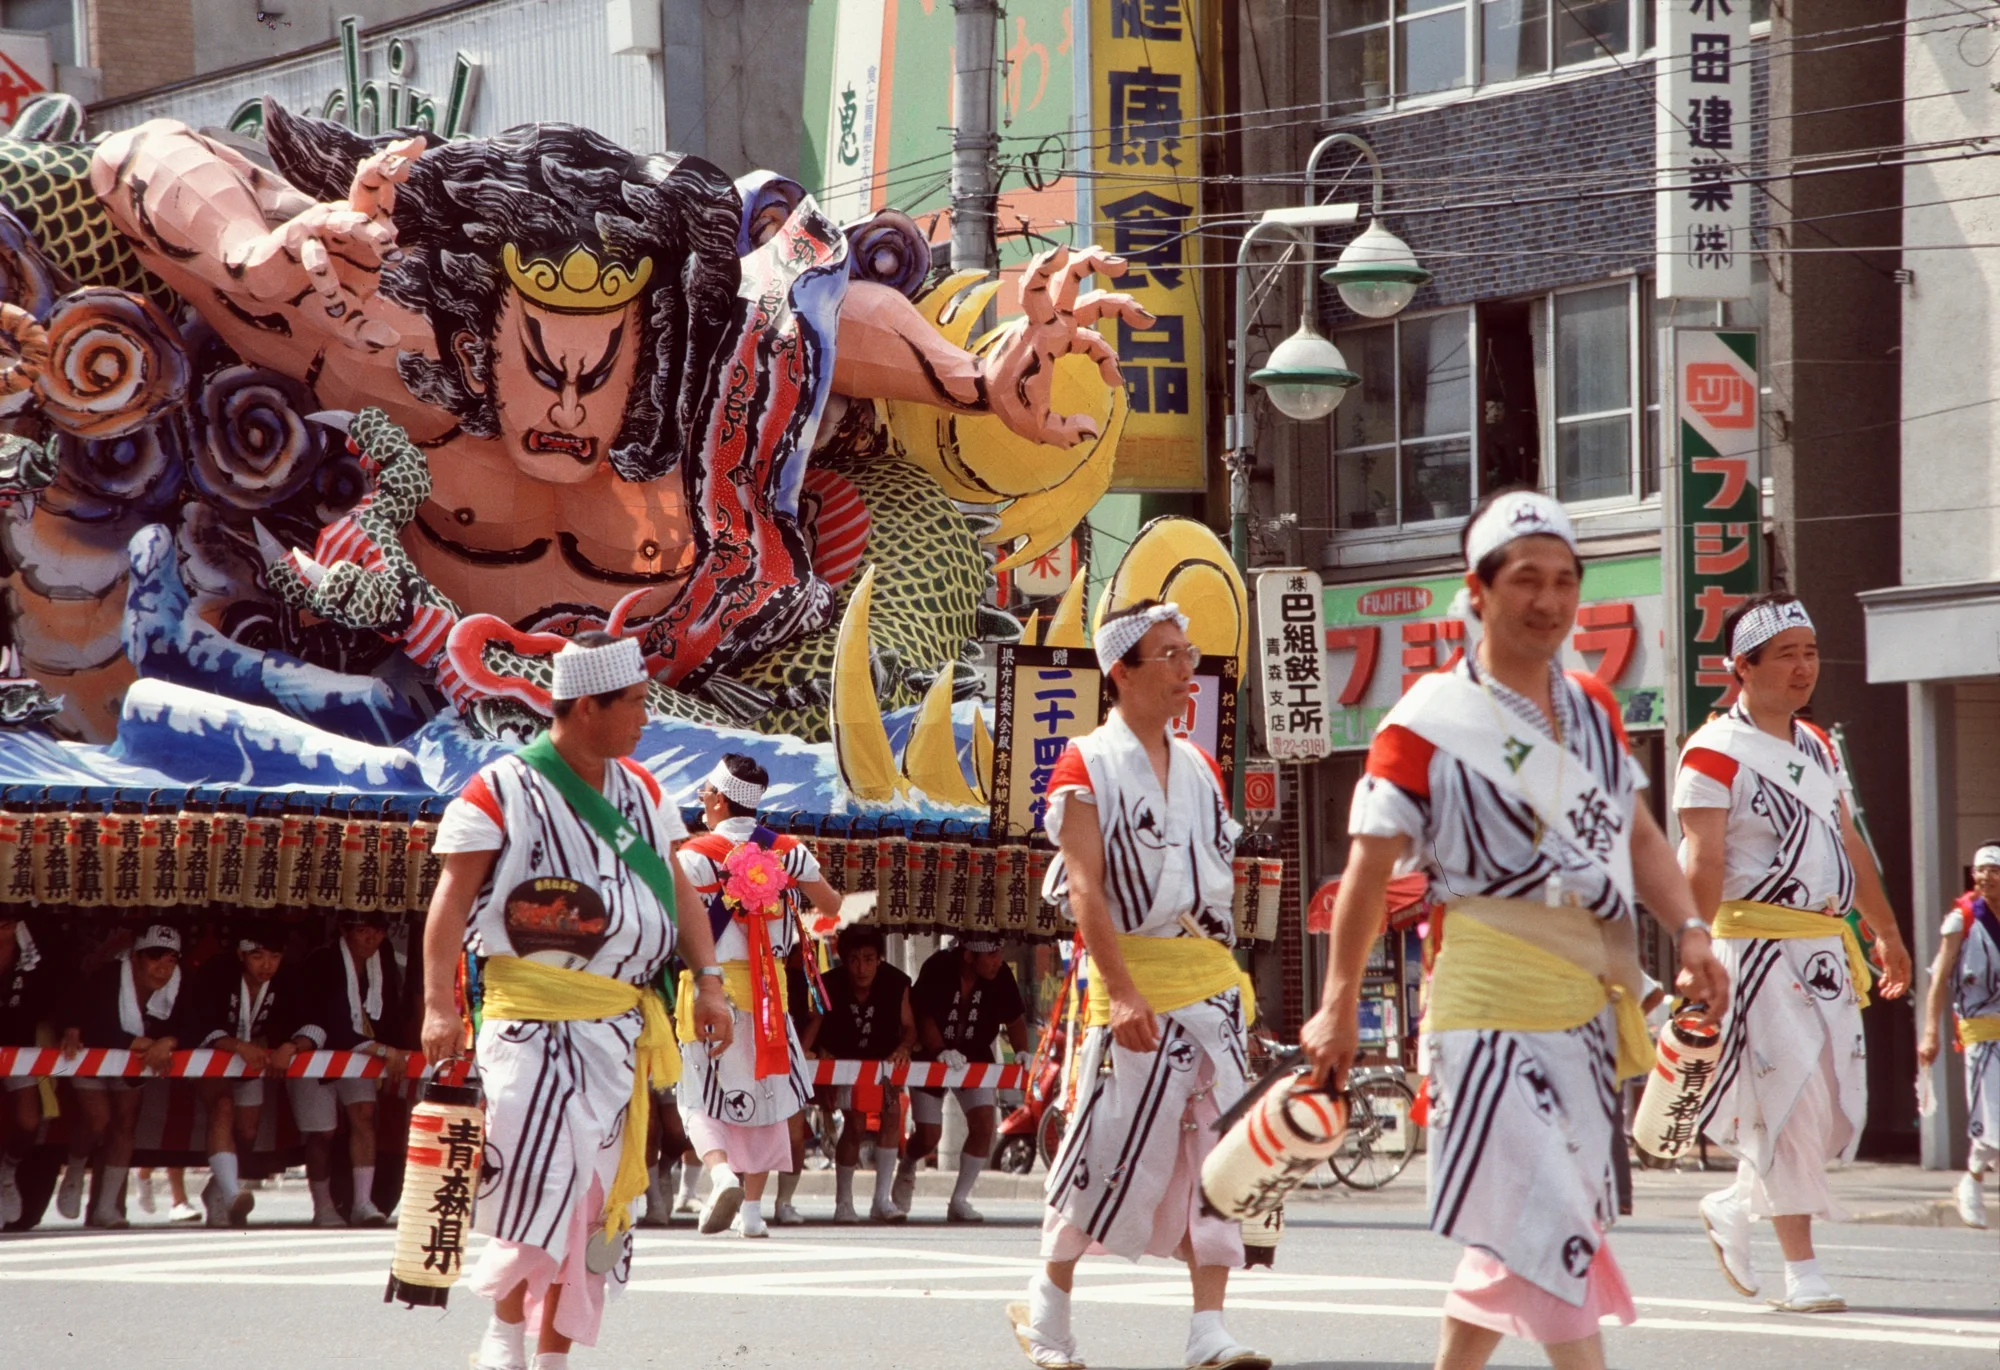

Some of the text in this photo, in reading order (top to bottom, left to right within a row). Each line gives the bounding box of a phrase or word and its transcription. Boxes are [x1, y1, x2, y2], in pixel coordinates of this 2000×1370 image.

[1362, 589, 1428, 615] FUJIFILM
[1266, 637, 1286, 733] 青森支店
[43, 818, 71, 899] 青森県
[74, 818, 104, 900] 青森県
[114, 820, 144, 899] 青森県
[153, 819, 179, 899] 青森県
[183, 819, 213, 899] 青森県
[218, 819, 246, 895] 青森県
[254, 823, 282, 900] 青森県
[315, 822, 347, 900] 青森県
[355, 825, 381, 906] 青森県
[383, 828, 409, 905] 青森県
[887, 843, 909, 918] 青森県
[916, 847, 941, 919] 青森県
[946, 849, 970, 924] 青森県
[974, 853, 997, 925] 青森県
[1007, 851, 1029, 924] 青森県
[1660, 1058, 1715, 1156] 青森県
[421, 1118, 481, 1275] 青森県
